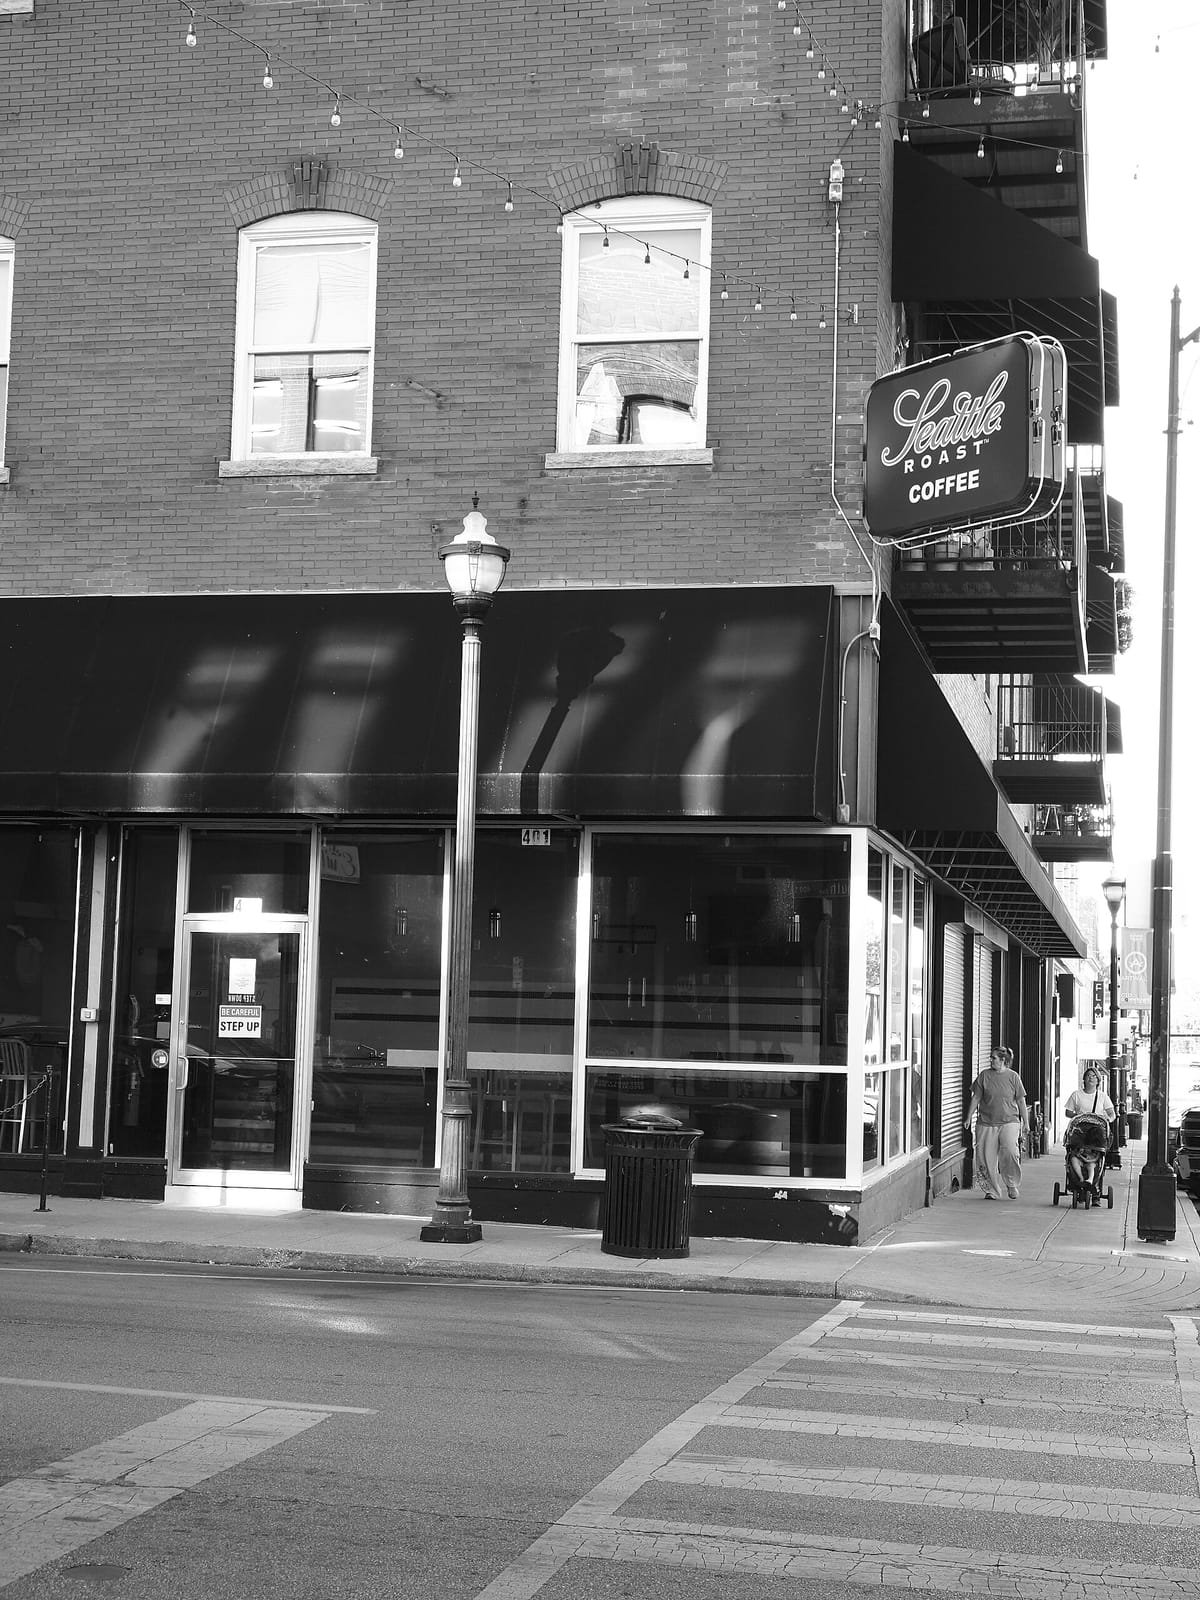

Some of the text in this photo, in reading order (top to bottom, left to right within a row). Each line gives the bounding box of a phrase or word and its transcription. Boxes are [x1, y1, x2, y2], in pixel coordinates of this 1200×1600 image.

[881, 370, 1008, 467] Seattle
[904, 441, 983, 474] ROAST
[909, 468, 980, 504] COFFEE
[523, 829, 549, 845] 401
[221, 1008, 260, 1017] BE CAREFUL
[220, 1021, 260, 1032] STEP UP
